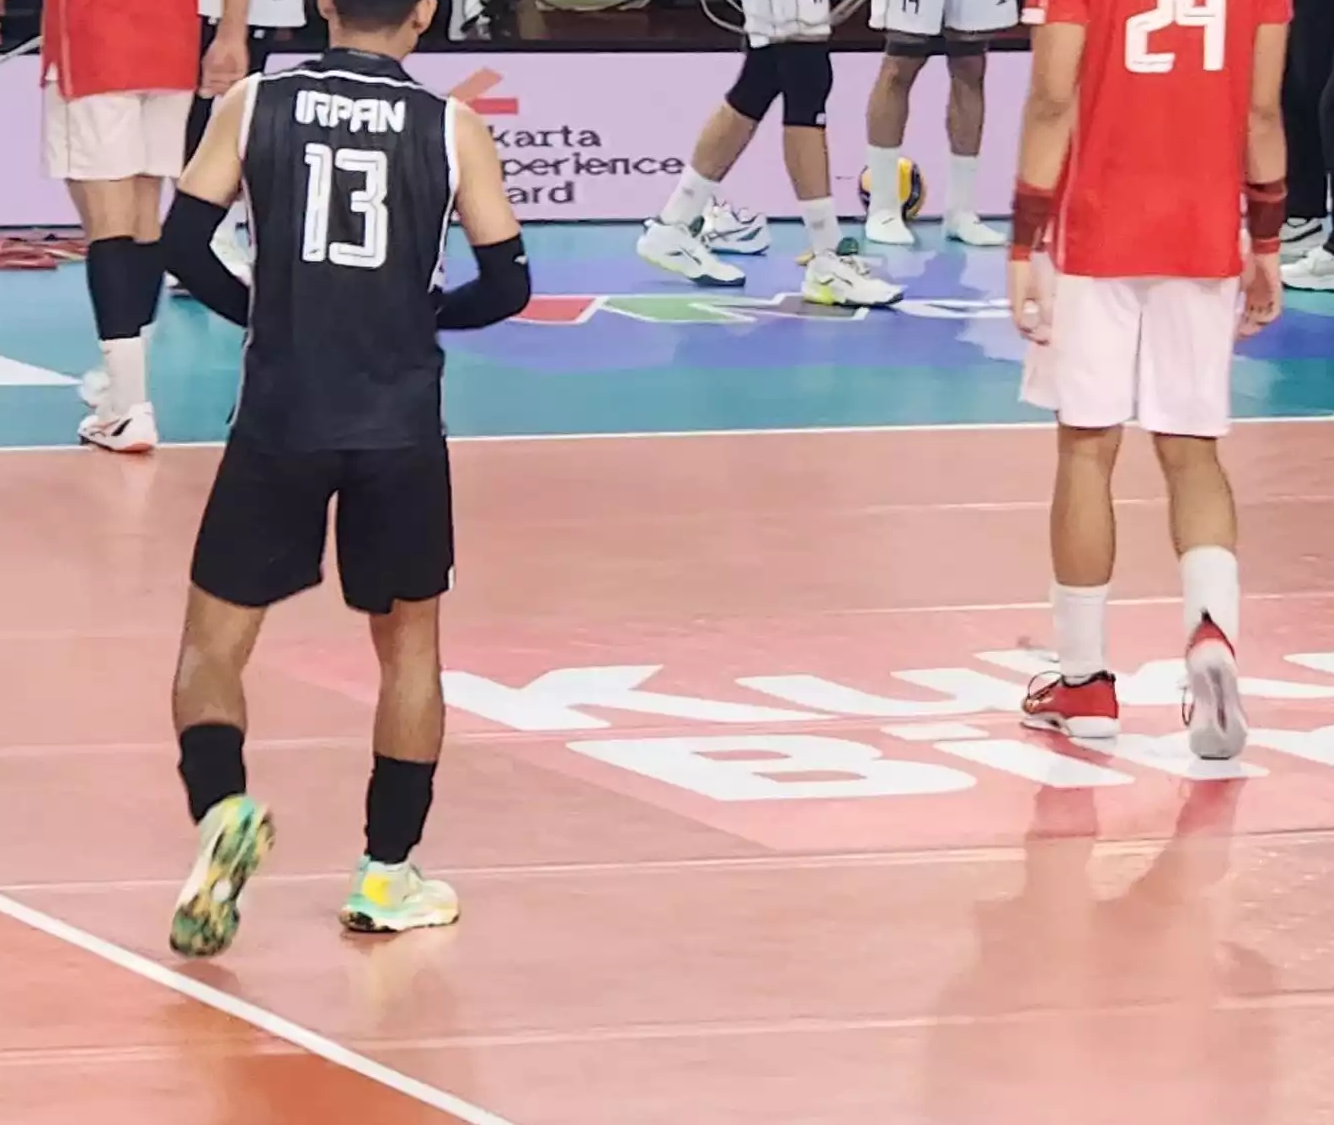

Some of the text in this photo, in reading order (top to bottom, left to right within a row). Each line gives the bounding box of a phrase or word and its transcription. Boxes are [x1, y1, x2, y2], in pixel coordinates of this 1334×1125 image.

[488, 125, 602, 148] karta
[502, 152, 686, 182] perience
[302, 142, 388, 270] 13
